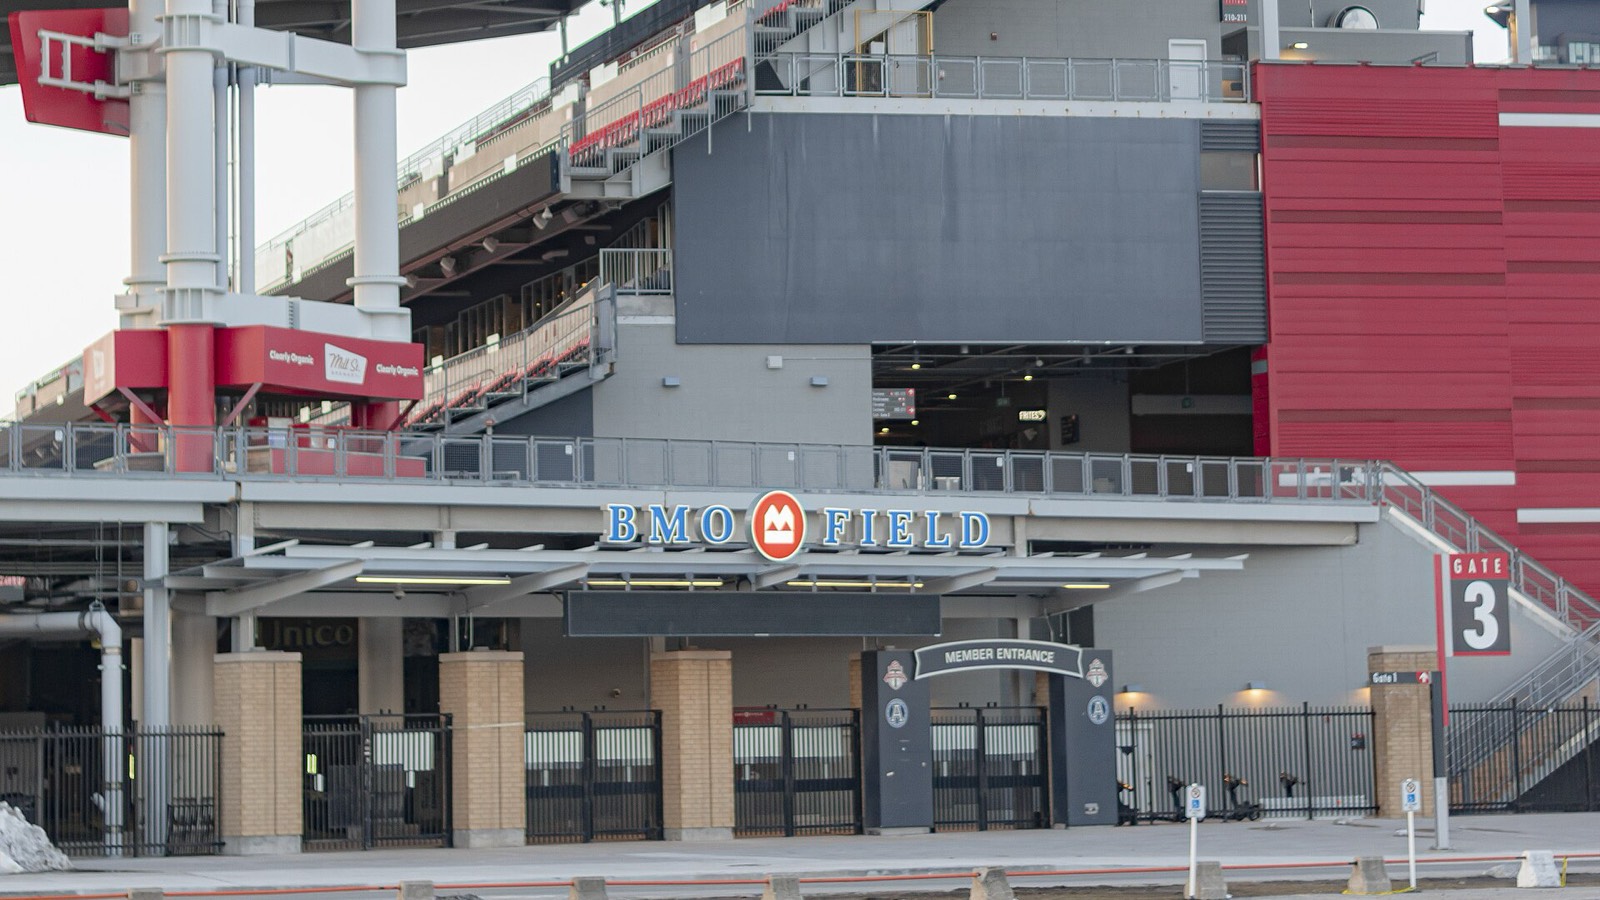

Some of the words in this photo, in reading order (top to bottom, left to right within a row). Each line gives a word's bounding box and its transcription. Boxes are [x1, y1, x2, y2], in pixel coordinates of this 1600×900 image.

[269, 350, 291, 363] Clearly
[291, 352, 314, 365] Organic
[329, 353, 350, 369] Mill
[376, 363, 397, 377] Clearly
[397, 365, 419, 377] Organic
[607, 503, 735, 545] BMO
[823, 507, 991, 549] FIELD
[1453, 557, 1502, 574] GATE
[1463, 580, 1499, 650] 3
[944, 648, 994, 663] MEMBER
[996, 648, 1056, 663] ENTRANCE
[1372, 671, 1392, 684] Gate
